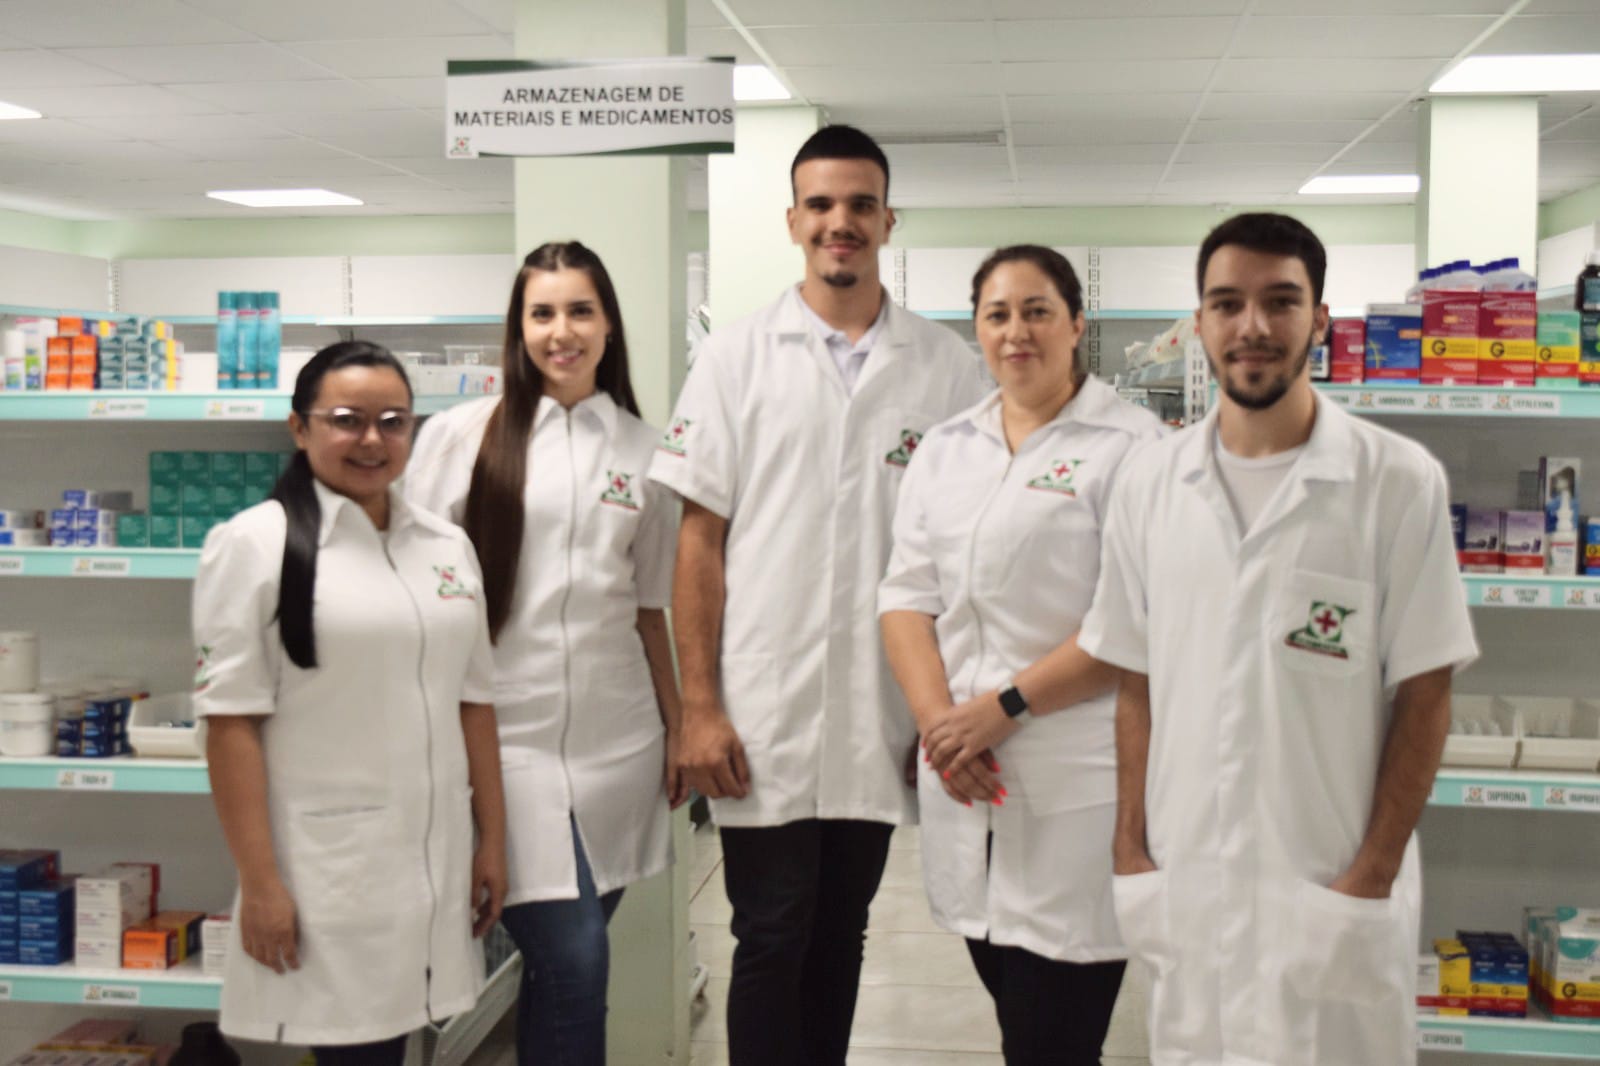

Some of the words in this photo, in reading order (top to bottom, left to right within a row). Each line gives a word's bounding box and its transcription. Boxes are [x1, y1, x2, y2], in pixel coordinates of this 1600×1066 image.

[503, 86, 653, 104] ARMAZENAGEM
[659, 86, 685, 102] DE
[454, 110, 555, 127] MATERIAIS
[561, 110, 573, 126] E
[579, 108, 734, 125] MEDICAMENTOS
[1486, 790, 1527, 803] DIPIRONA
